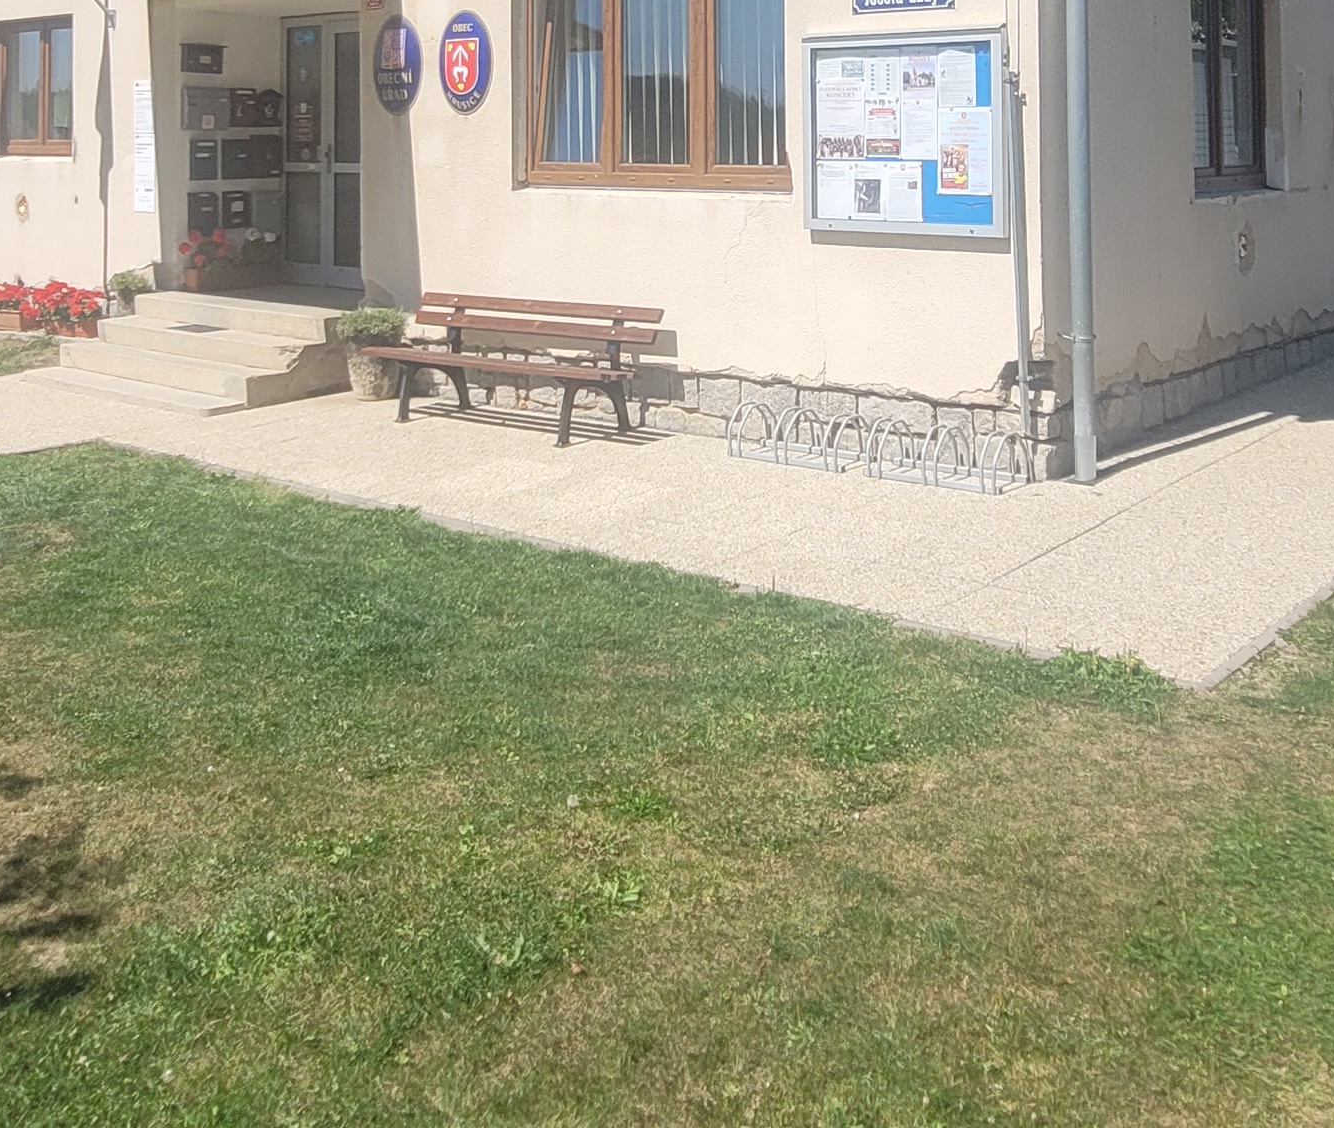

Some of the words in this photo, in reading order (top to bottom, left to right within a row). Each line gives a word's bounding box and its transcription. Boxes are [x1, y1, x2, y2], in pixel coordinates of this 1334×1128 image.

[452, 23, 474, 33] OBEC
[377, 68, 413, 85] OBECNÍ
[446, 91, 481, 110] HRUSICE
